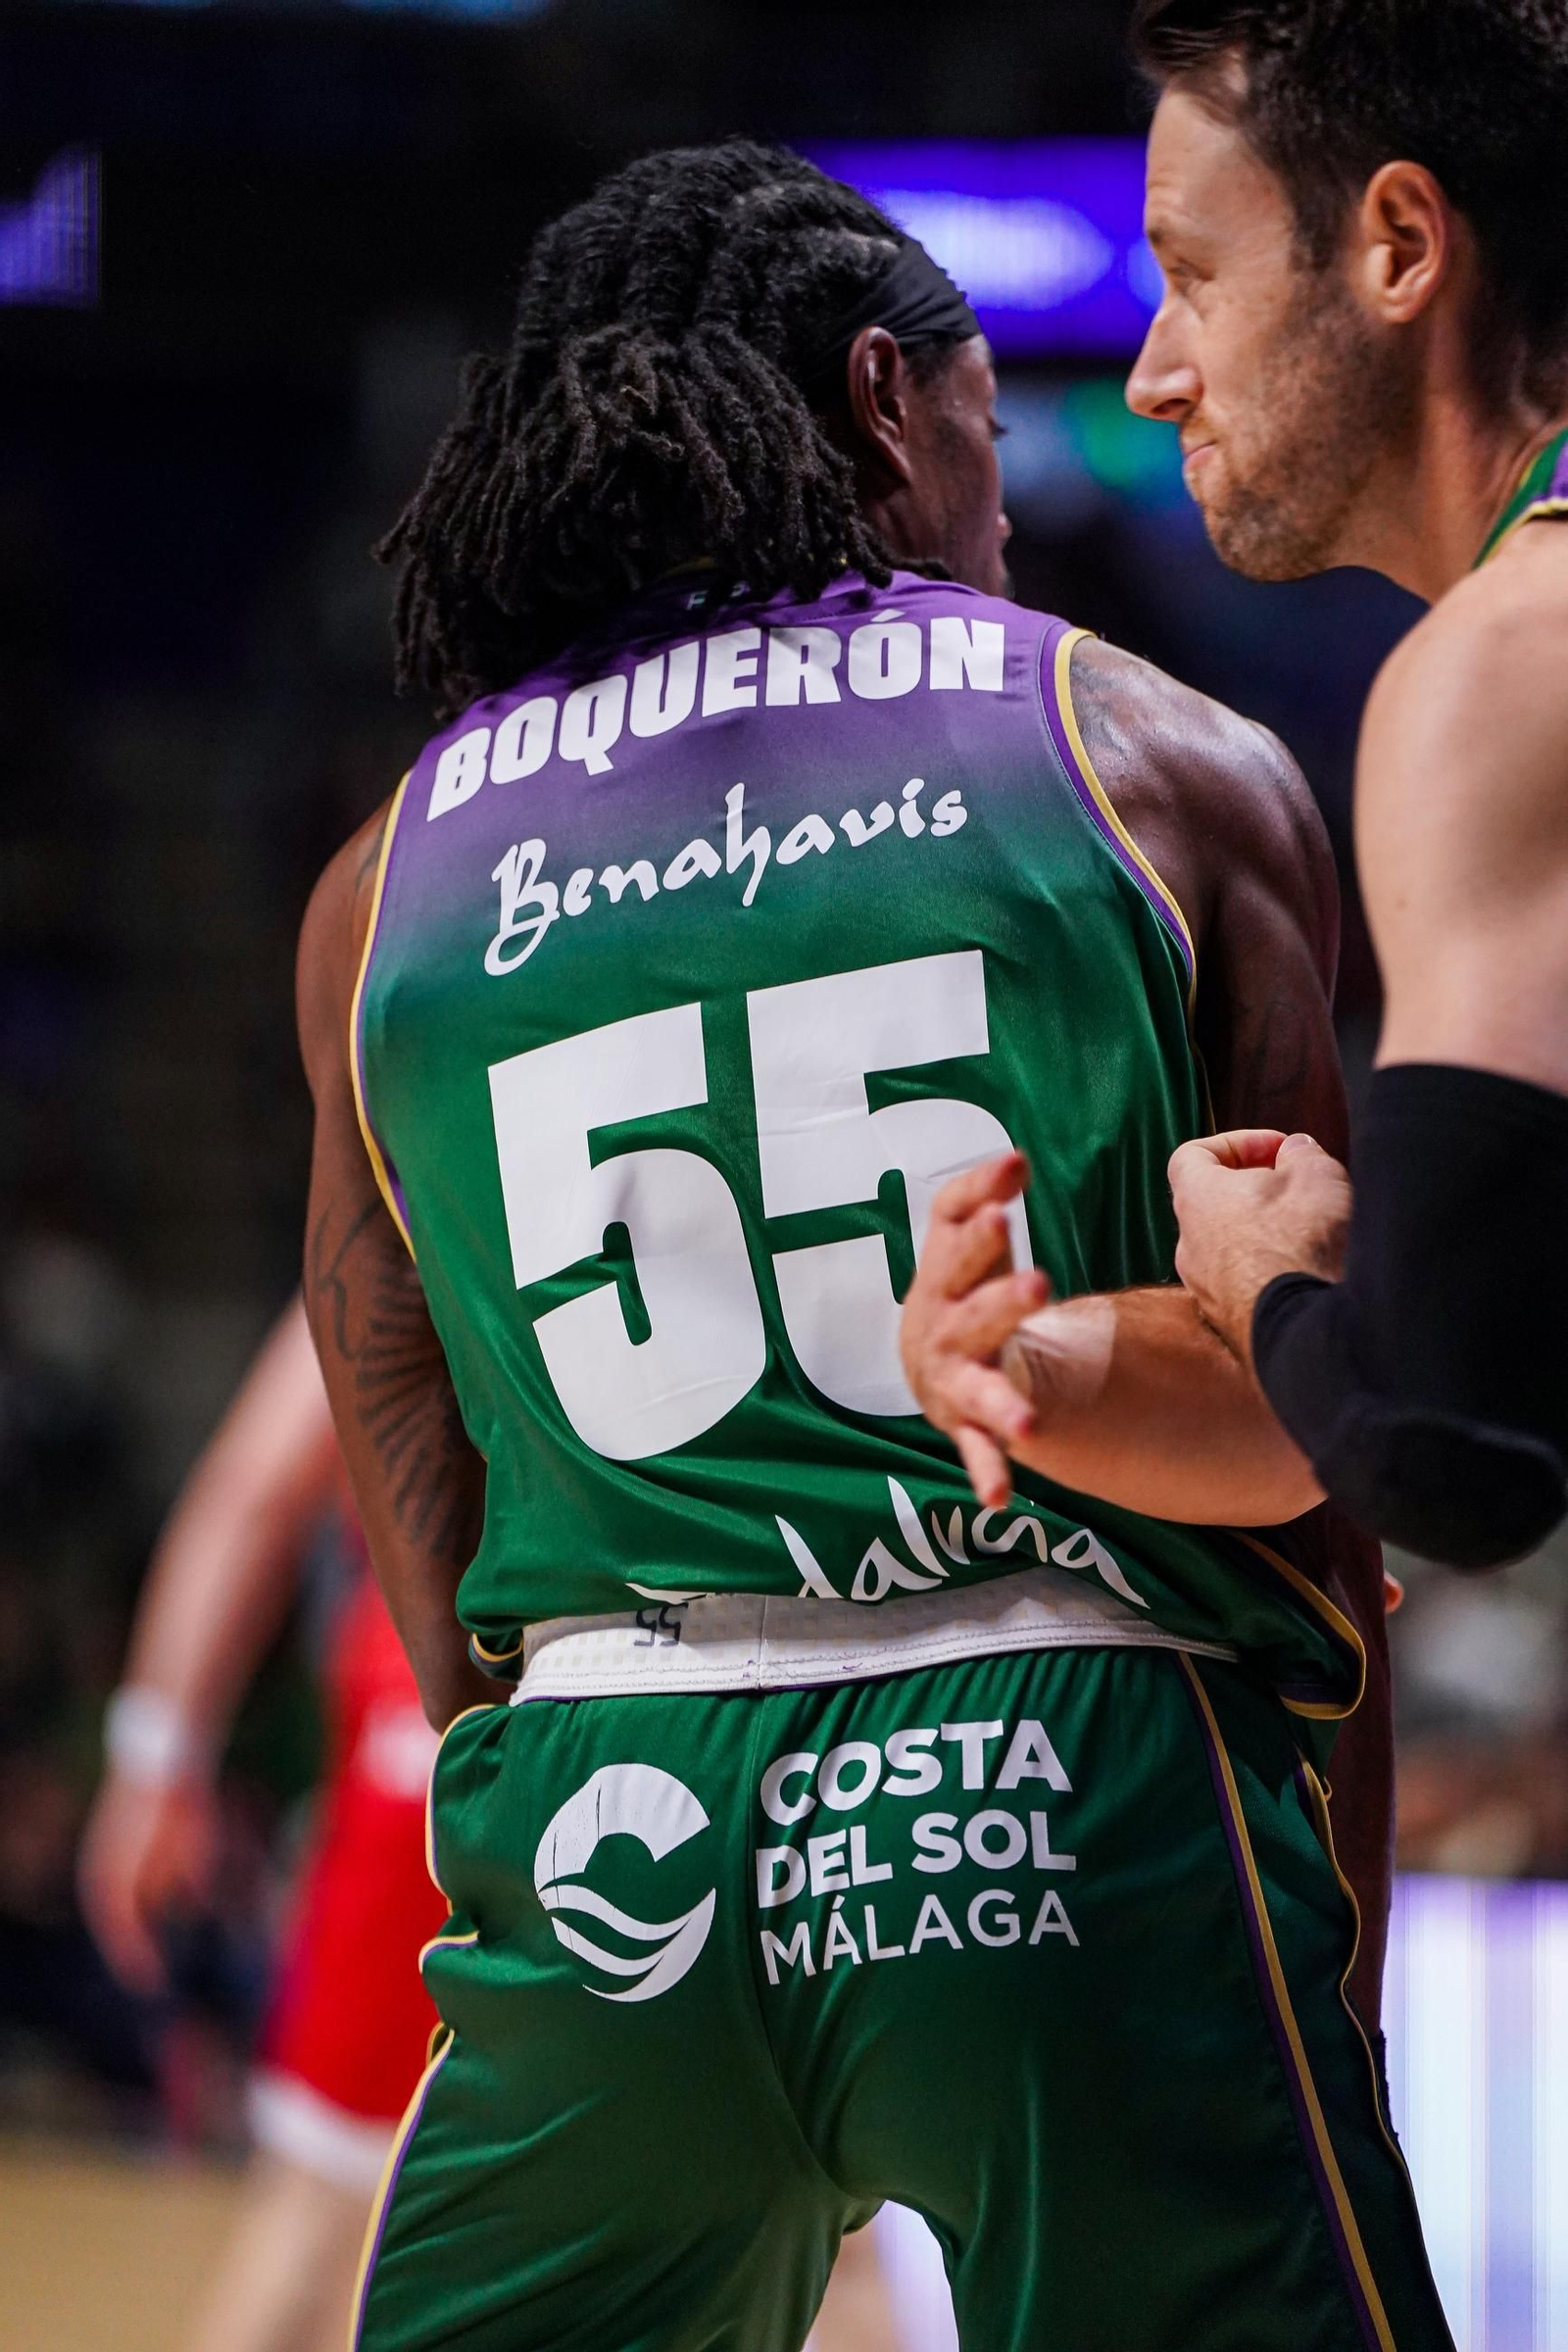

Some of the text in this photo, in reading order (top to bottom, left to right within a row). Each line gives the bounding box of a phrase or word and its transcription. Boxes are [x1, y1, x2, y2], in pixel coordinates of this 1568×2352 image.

[426, 610, 1004, 821] BOQUERÓN
[488, 950, 1034, 1461] 55
[760, 1719, 1073, 1826] COSTA
[755, 1809, 1076, 1908] DEL SOL
[760, 1889, 1080, 1985] MÁLAGA
